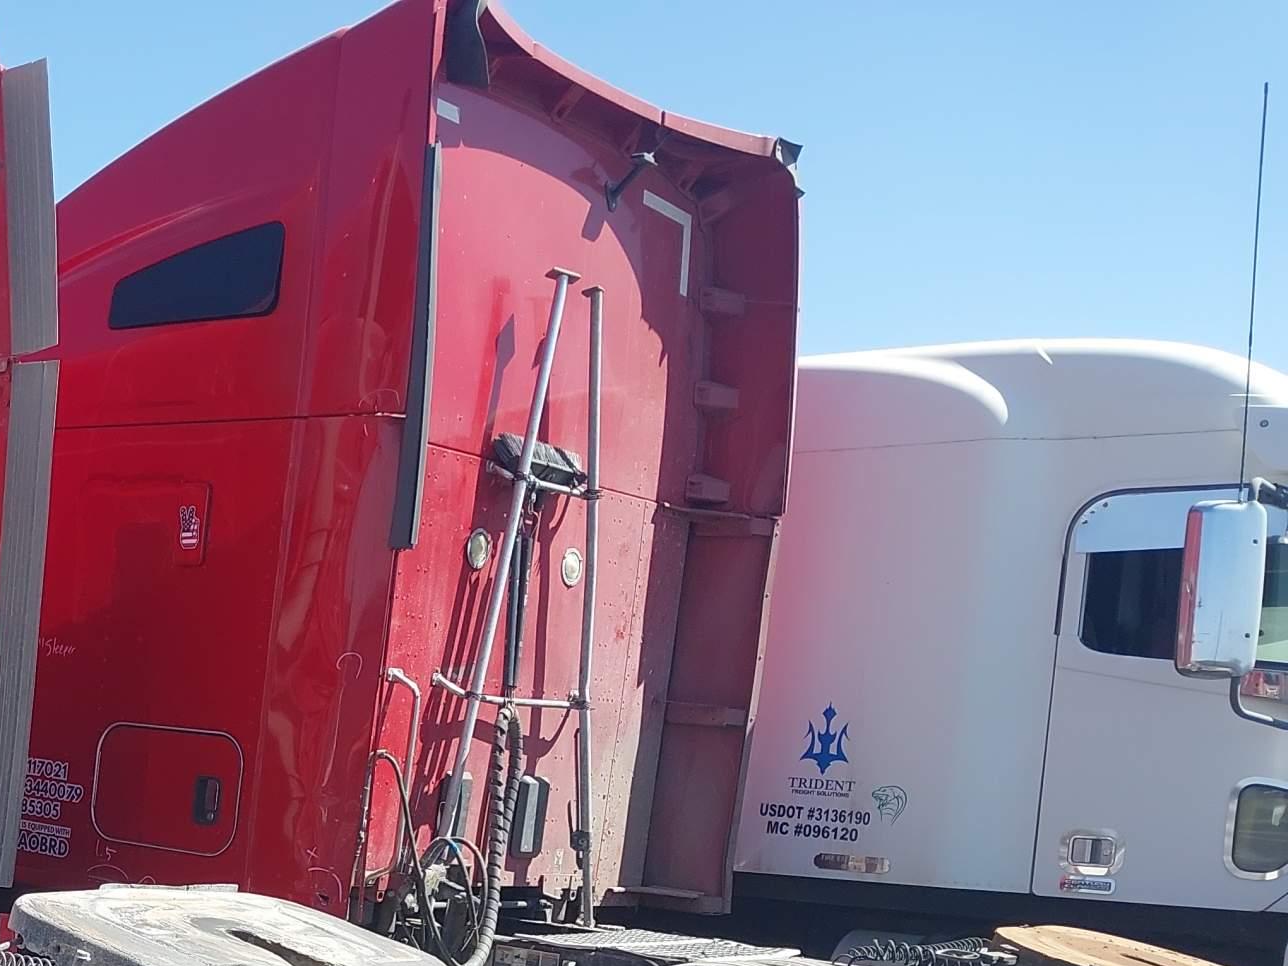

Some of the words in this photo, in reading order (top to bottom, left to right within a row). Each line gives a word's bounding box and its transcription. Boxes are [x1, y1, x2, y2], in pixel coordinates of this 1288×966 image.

[788, 777, 856, 792] TRIDENT
[759, 803, 804, 820] USDOT
[807, 807, 871, 825] #3136190
[766, 821, 789, 836] MC
[794, 824, 859, 842] #096120
[18, 830, 68, 856] AOBRD
